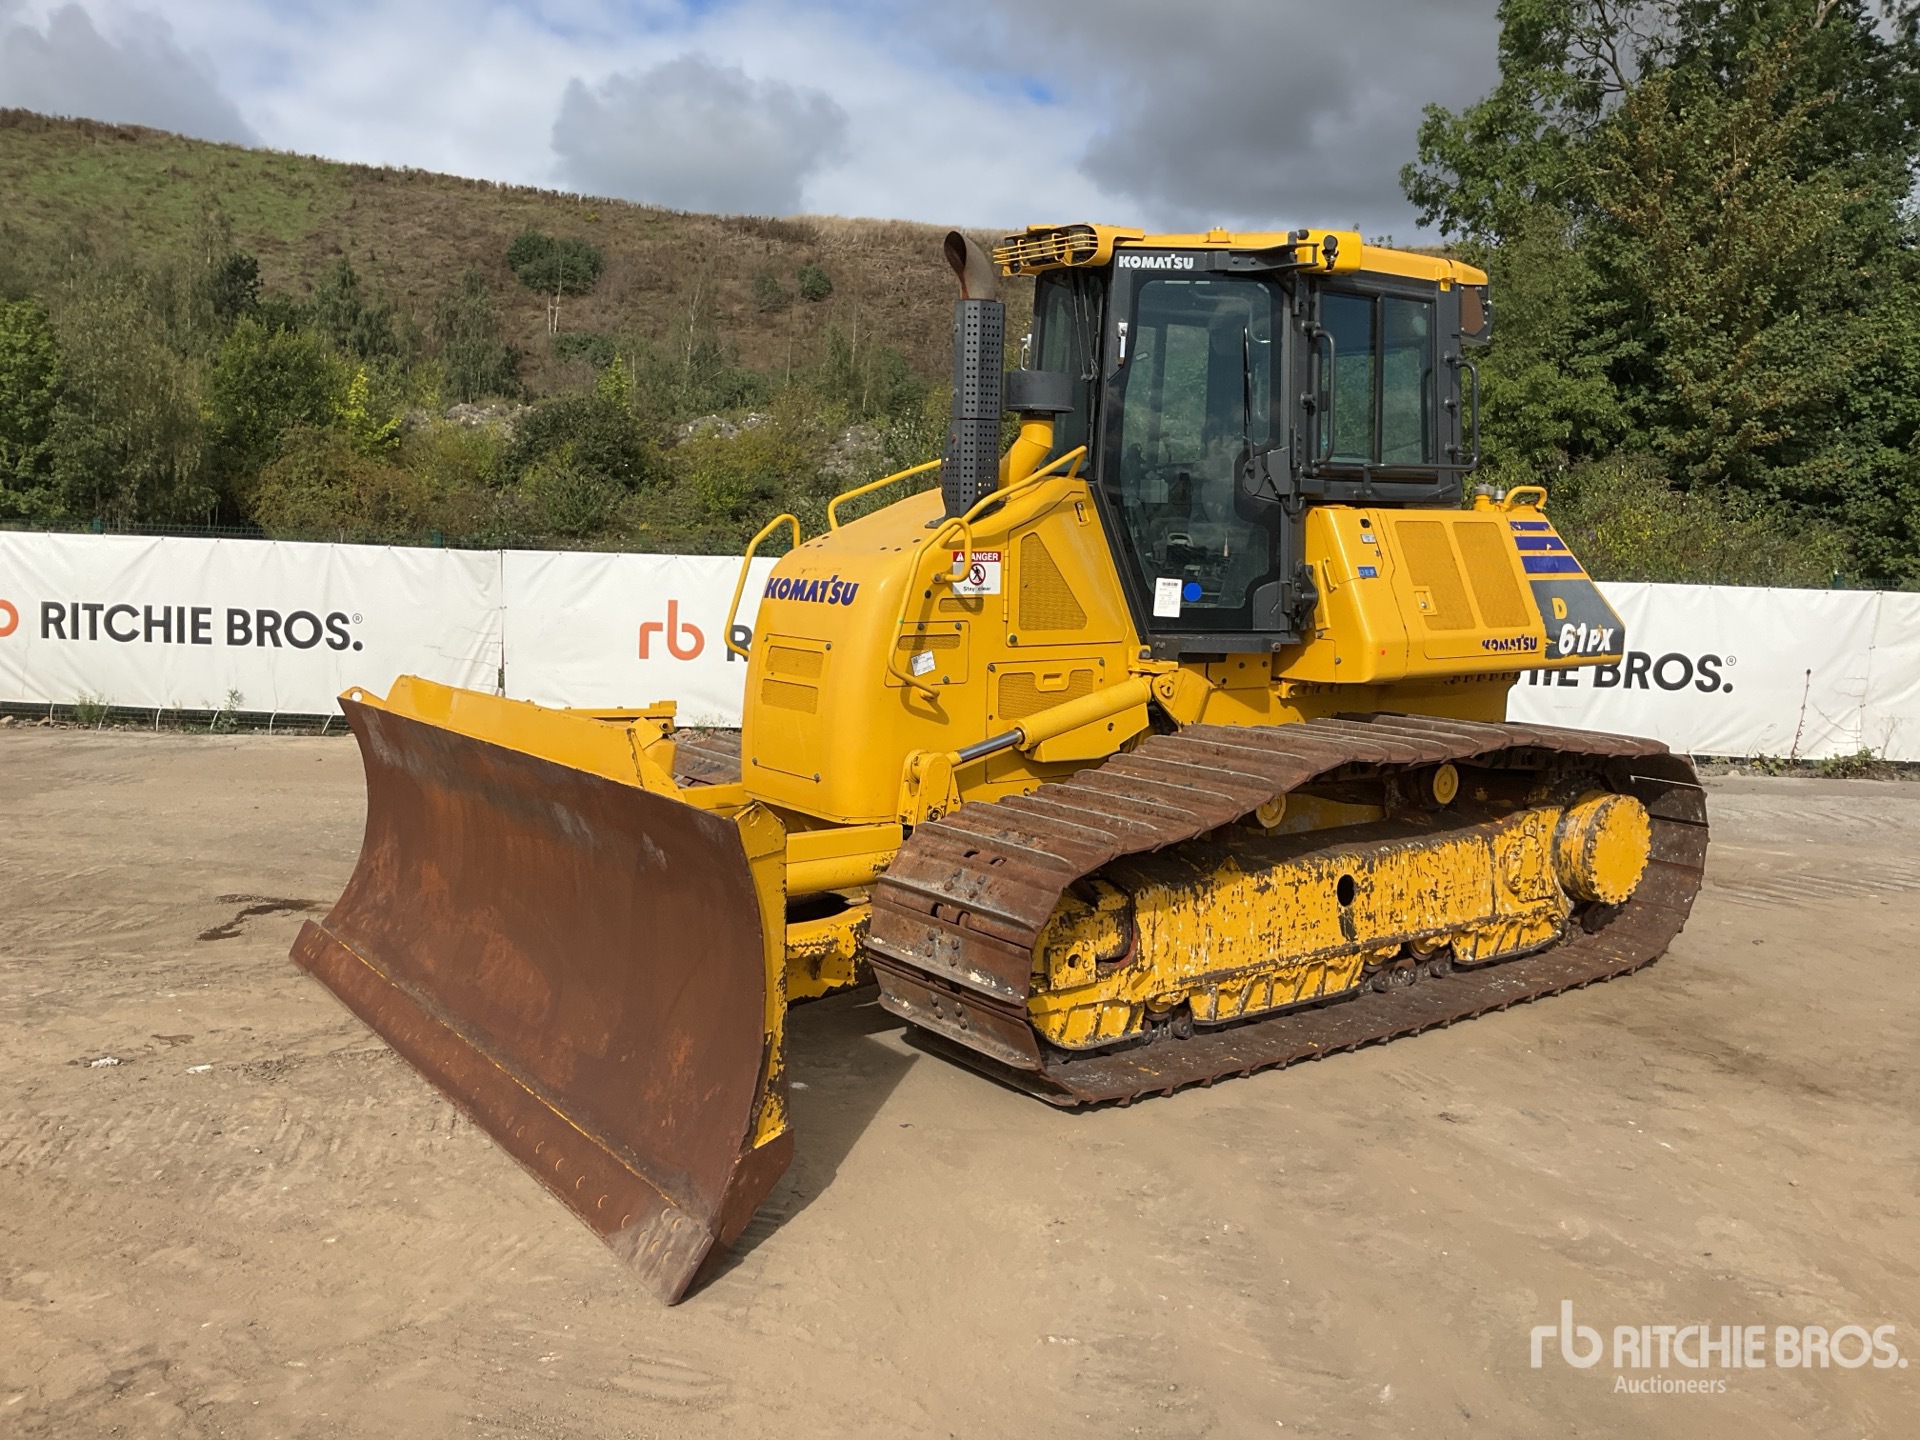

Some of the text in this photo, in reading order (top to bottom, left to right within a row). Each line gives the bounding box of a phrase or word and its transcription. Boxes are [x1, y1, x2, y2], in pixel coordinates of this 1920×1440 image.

[1118, 253, 1194, 270] KOMATSU
[971, 552, 999, 561] ANGER
[763, 574, 860, 607] KOMATSU
[1551, 597, 1568, 620] D
[40, 600, 213, 645] RITCHIE
[226, 607, 364, 652] BROS.
[638, 599, 706, 661] rb
[1481, 634, 1538, 652] KOMATSU
